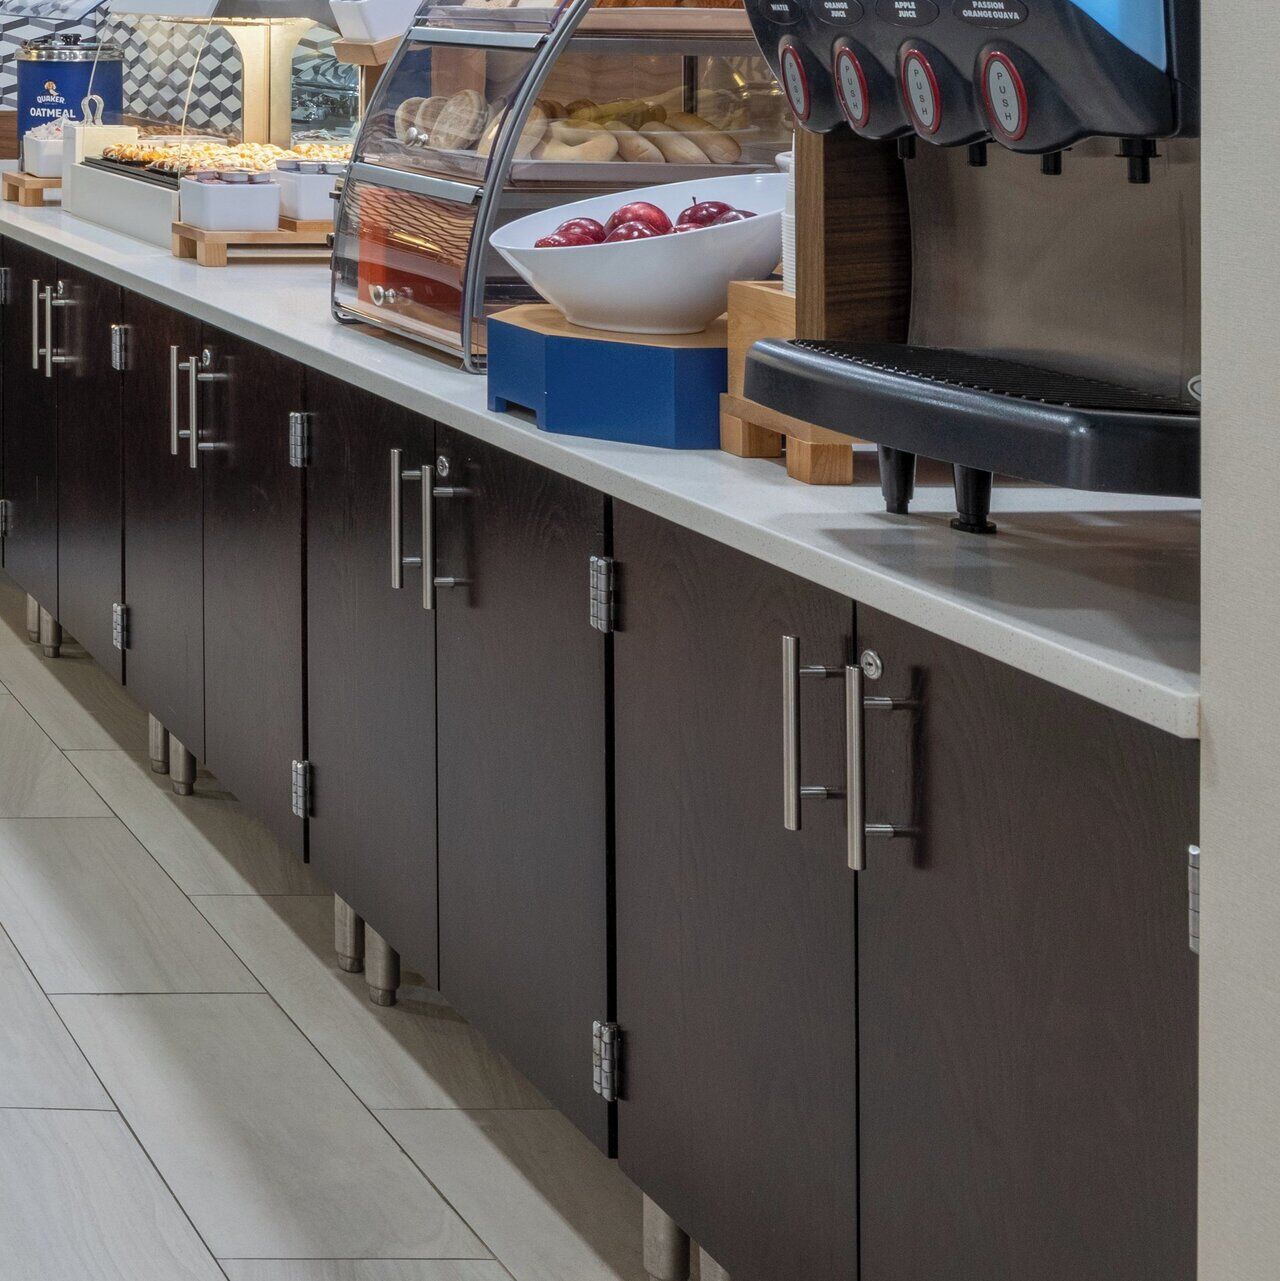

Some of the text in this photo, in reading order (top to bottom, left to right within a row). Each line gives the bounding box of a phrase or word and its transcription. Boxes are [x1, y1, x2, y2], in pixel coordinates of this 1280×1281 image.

[894, 1, 916, 9] APPLE
[972, 1, 1004, 9] PASSION
[831, 10, 846, 18] JUICE
[899, 10, 917, 18] JUICE
[962, 10, 1020, 20] ORANGE GUAVA
[845, 65, 859, 110] PUSH
[913, 69, 928, 116] PUSH
[996, 72, 1013, 121] PUSH
[36, 95, 65, 104] QUAKER
[29, 107, 76, 118] OATMEAL
